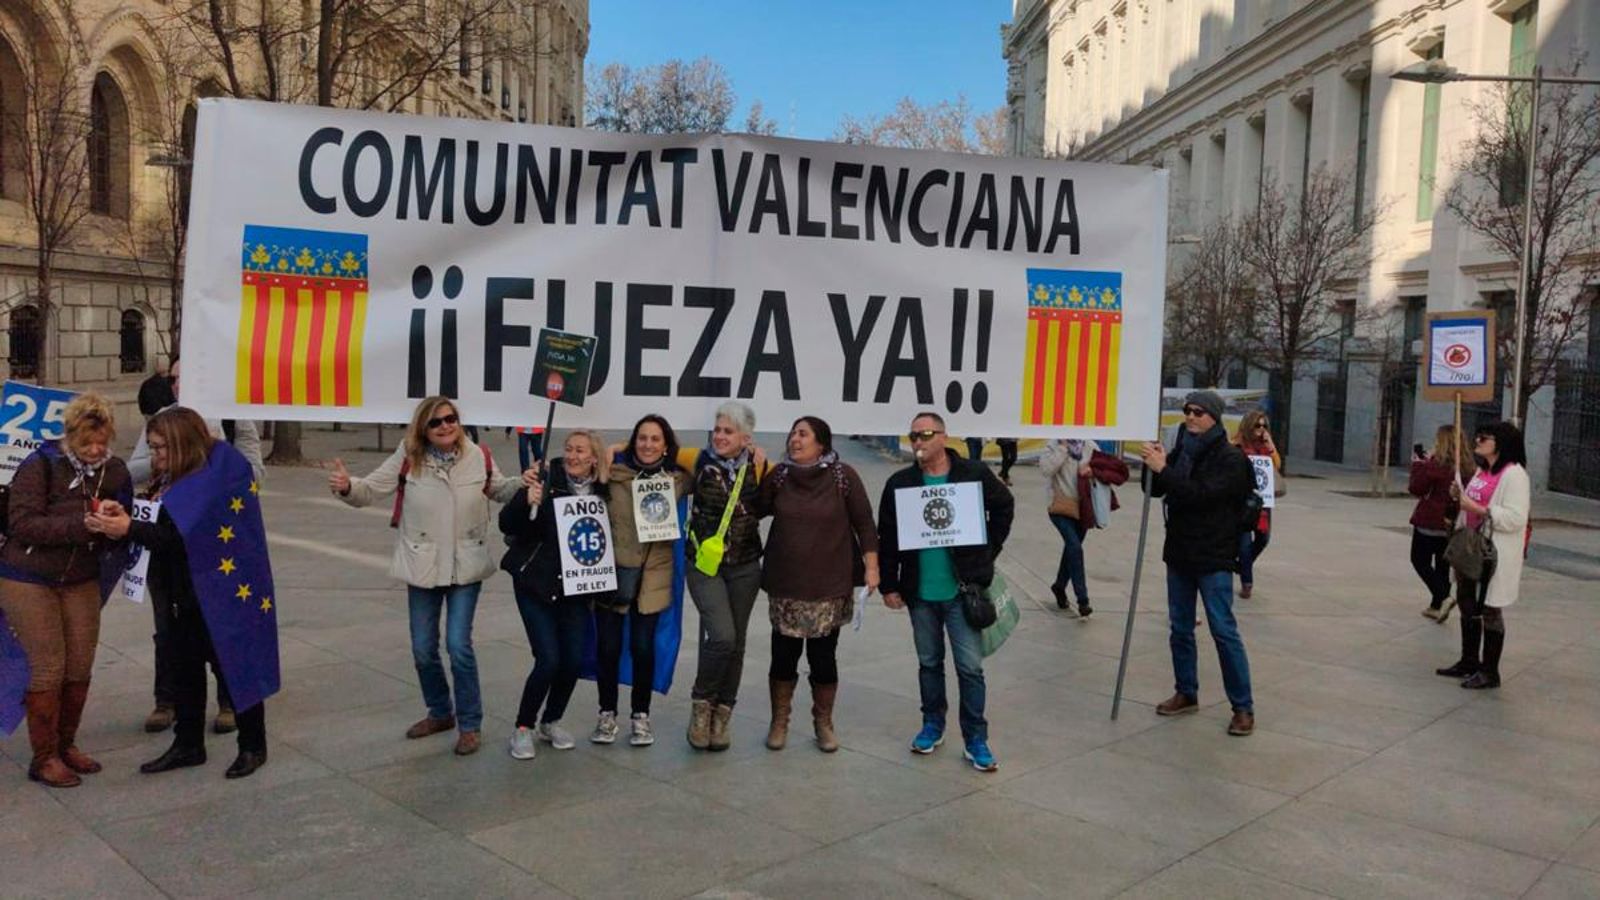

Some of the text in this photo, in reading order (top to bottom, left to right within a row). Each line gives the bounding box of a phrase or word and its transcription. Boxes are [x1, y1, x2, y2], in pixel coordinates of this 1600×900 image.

[298, 126, 1081, 256] COMUNITAT VALENCIANA
[827, 287, 994, 415] YA!!
[0, 393, 66, 440] 25
[637, 481, 671, 493] AÑOS
[920, 486, 957, 498] AÑOS
[563, 499, 605, 516] AÑOS
[930, 507, 948, 520] 30
[577, 531, 600, 552] 15
[565, 566, 614, 579] EN FRAUDE
[576, 581, 607, 592] DE LEY
